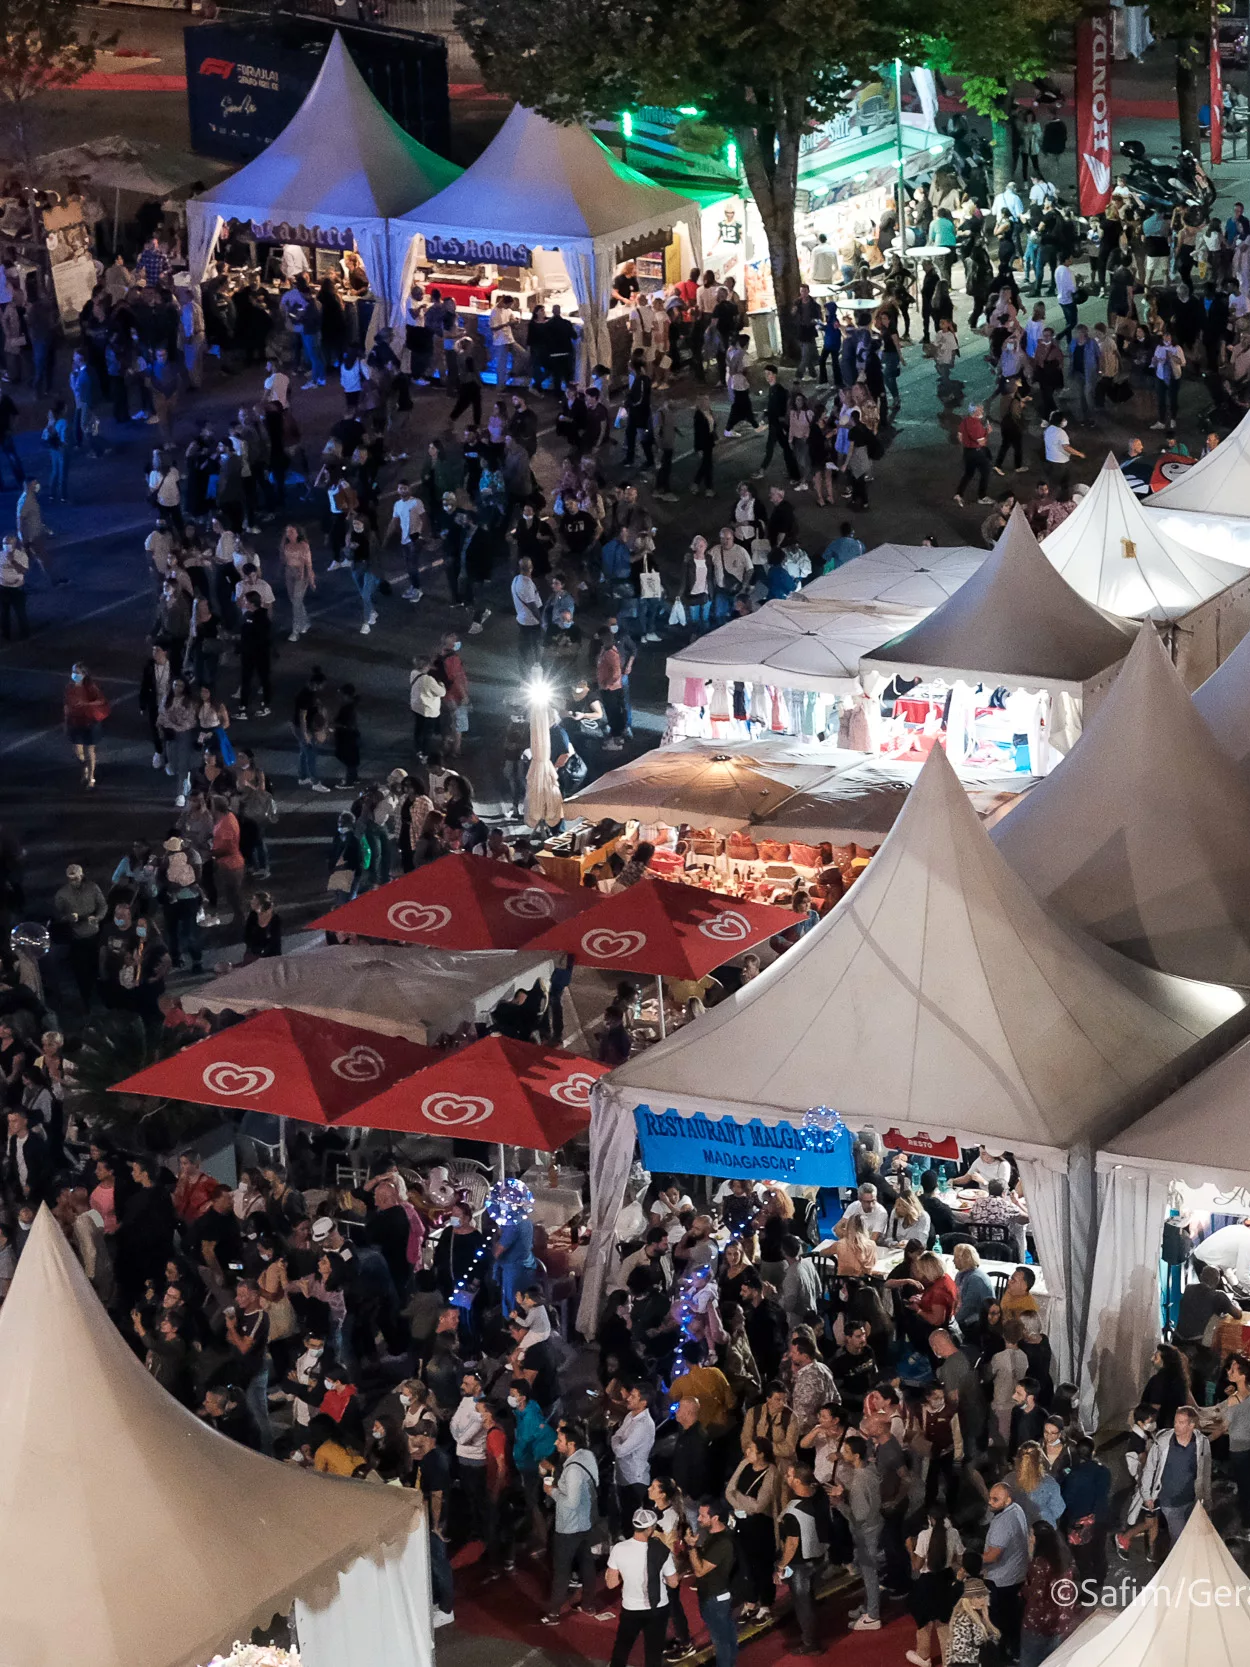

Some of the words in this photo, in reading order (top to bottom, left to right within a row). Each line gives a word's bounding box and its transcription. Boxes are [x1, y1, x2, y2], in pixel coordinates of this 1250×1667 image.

[1092, 16, 1109, 152] HONDA
[721, 226, 737, 241] 12
[644, 1112, 745, 1147] RESTAURANT
[907, 1139, 933, 1149] RESTO
[702, 1149, 797, 1172] MADAGASCAR
